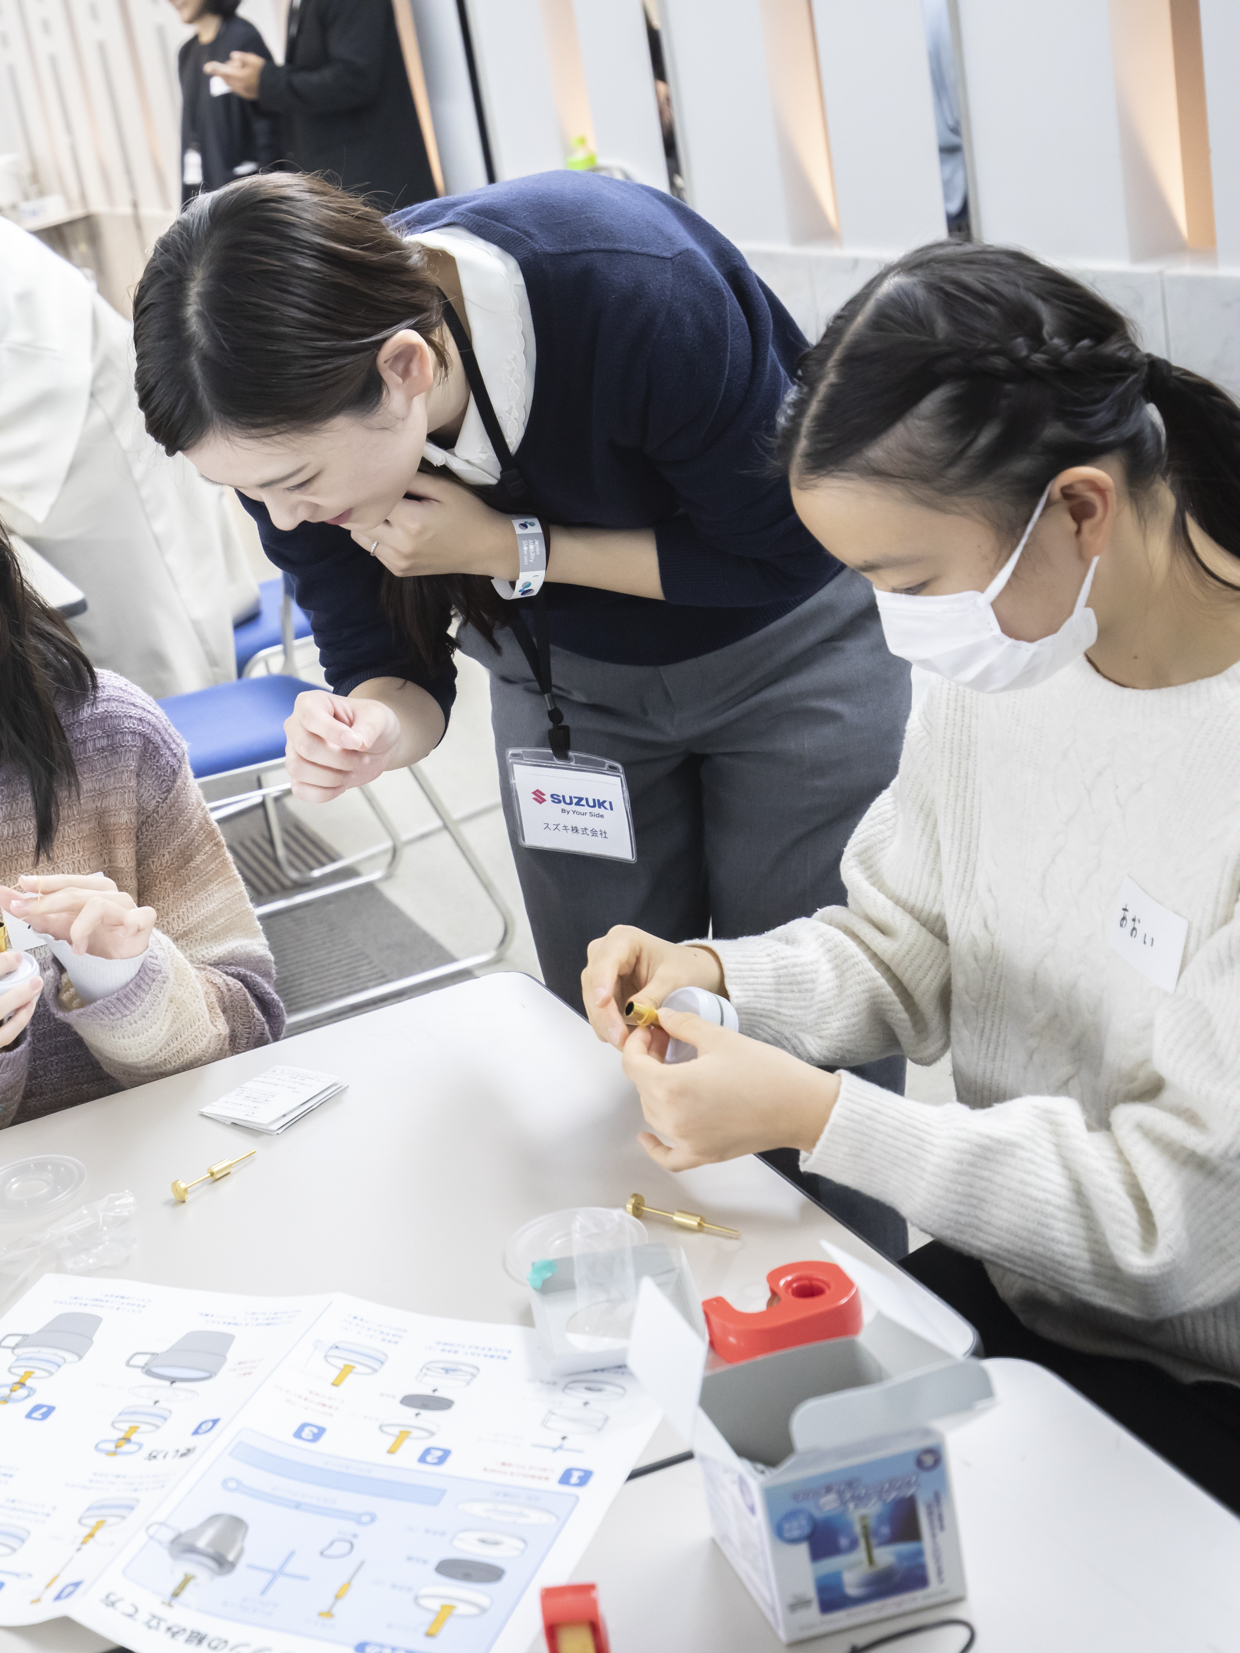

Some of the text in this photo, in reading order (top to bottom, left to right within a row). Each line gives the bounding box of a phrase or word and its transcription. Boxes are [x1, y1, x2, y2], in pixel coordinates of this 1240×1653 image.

[549, 793, 614, 811] SUZUKI
[561, 808, 605, 819] By Your Side
[543, 822, 609, 840] スズキ株式会社
[31, 1407, 48, 1419] 7
[300, 1426, 319, 1440] 3
[425, 1449, 444, 1463] 2
[569, 1472, 586, 1485] 1
